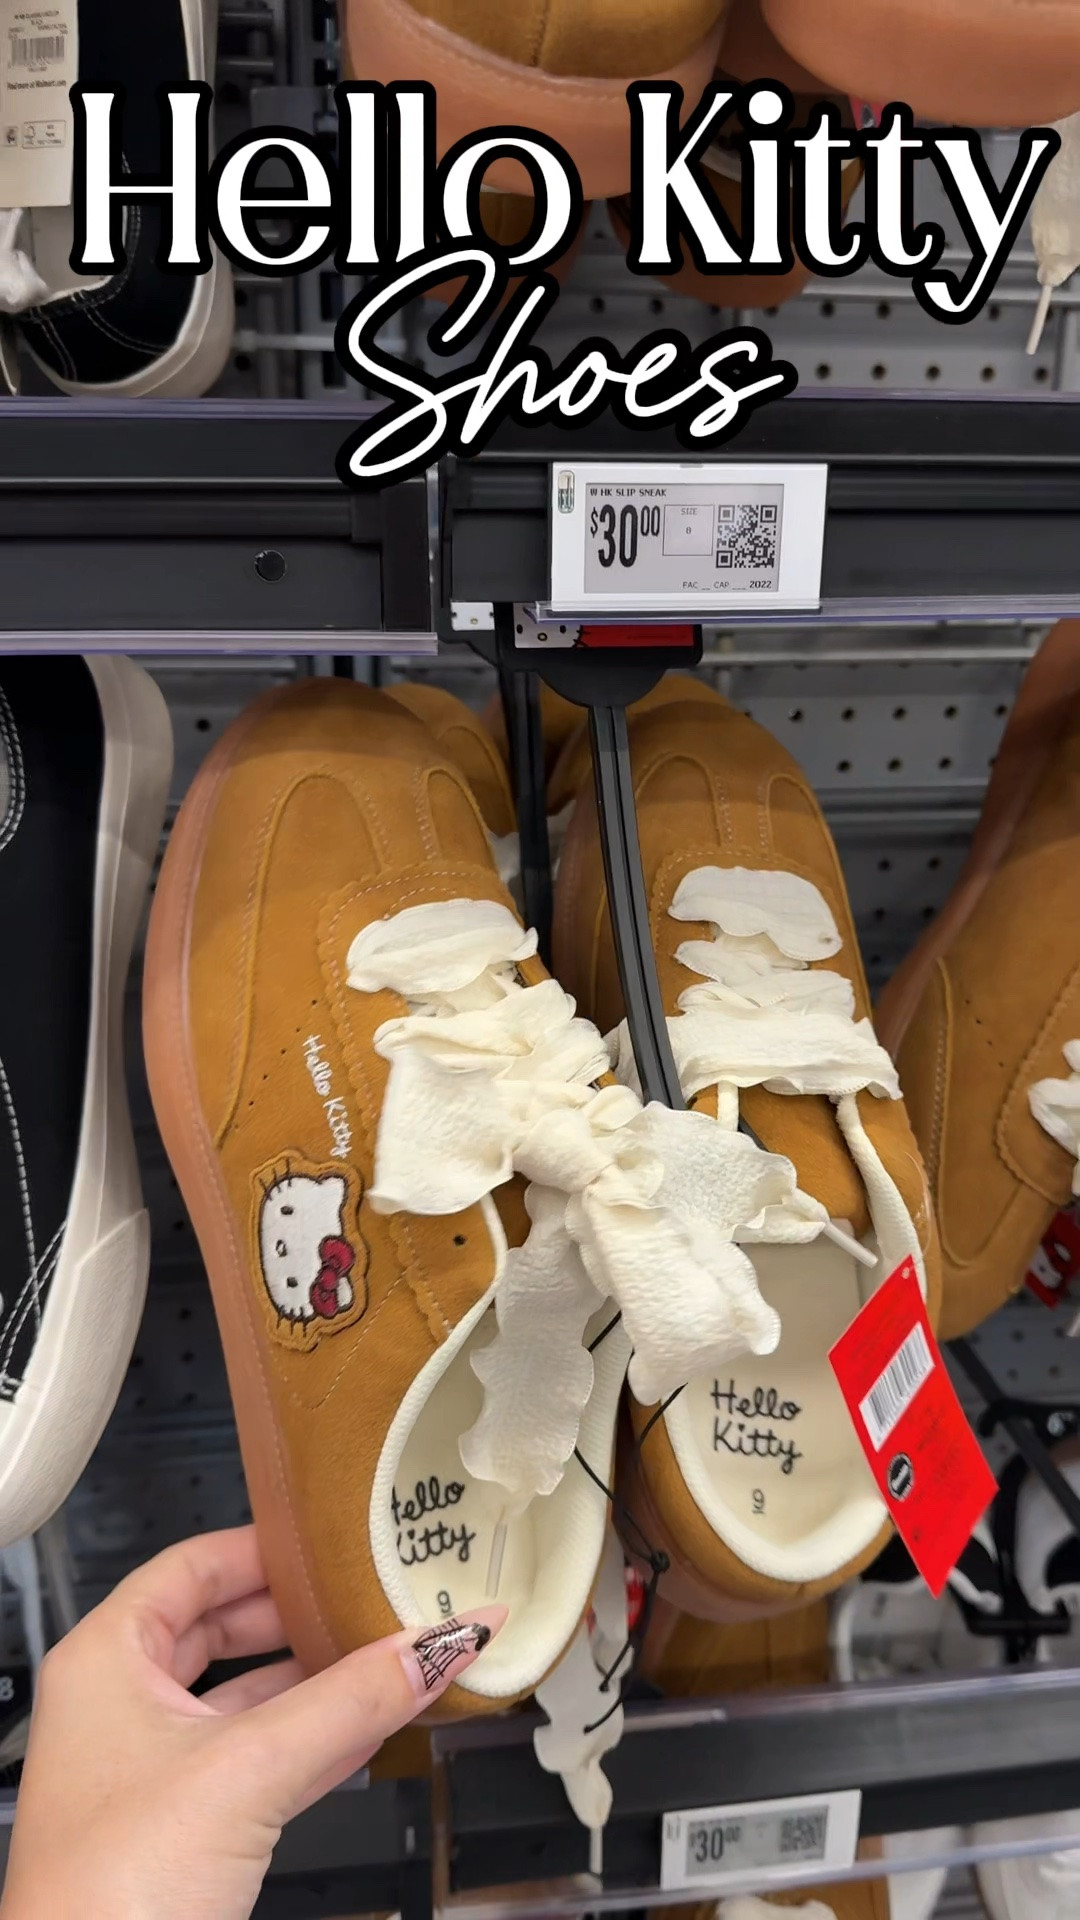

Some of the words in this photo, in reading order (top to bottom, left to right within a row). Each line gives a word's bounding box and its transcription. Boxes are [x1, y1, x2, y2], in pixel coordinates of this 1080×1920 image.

[590, 488, 598, 497] W
[600, 488, 613, 497] HK
[616, 488, 636, 497] SLIP
[639, 488, 667, 497] SNEAK
[681, 507, 698, 516] SIZE
[682, 581, 698, 589] FAC
[713, 581, 730, 589] CAP
[749, 580, 772, 589] 2022
[302, 1034, 333, 1097] Hello
[322, 1096, 353, 1159] Kitty
[710, 1378, 802, 1421] Hello
[713, 1416, 803, 1475] Kitty
[437, 1590, 452, 1614] 9
